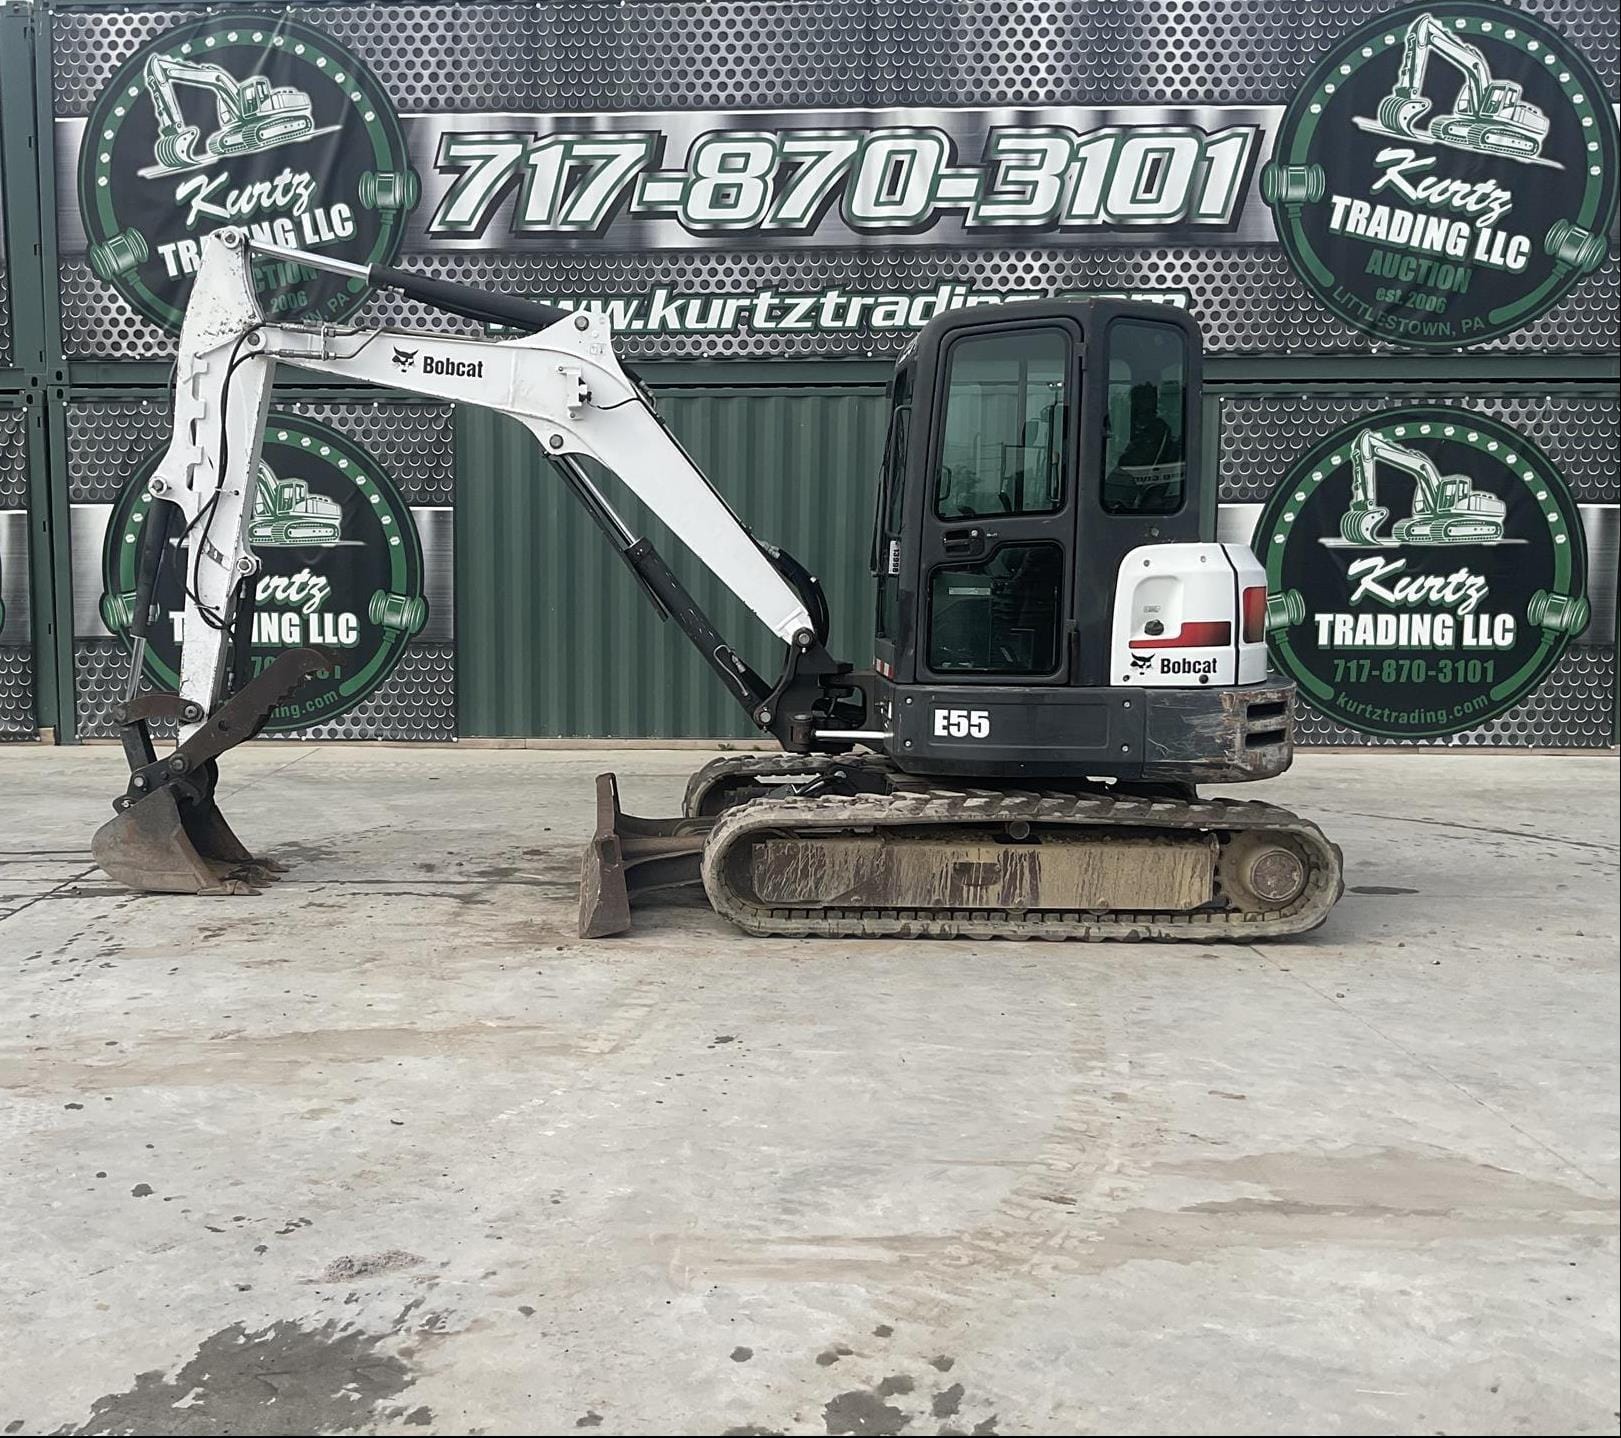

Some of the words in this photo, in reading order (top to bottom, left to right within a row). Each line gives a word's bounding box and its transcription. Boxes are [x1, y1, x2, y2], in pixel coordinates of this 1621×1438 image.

[175, 168, 317, 229] Kurtz
[430, 128, 1262, 235] 717-870-3101
[1370, 147, 1512, 226] Kurtz
[158, 217, 298, 277] TRNG
[302, 204, 355, 245] LLC
[1328, 195, 1471, 258] TRADING
[1474, 226, 1532, 270] LLC
[254, 258, 319, 293] CTION
[1365, 249, 1472, 294] AUCTION
[270, 291, 308, 314] 2006
[328, 291, 350, 312] PA
[1332, 285, 1456, 337] LITTLESTOWN,
[1461, 316, 1485, 333] PA
[1405, 291, 1447, 314] 2006
[423, 356, 483, 378] Bobcat
[1348, 556, 1489, 614] Kurtz
[309, 612, 358, 644] LLC
[1315, 613, 1455, 647] TRADING
[1463, 614, 1516, 647] LLC
[1160, 658, 1217, 674] Bobcat
[1333, 659, 1494, 683] 717-870-3101
[934, 709, 990, 738] E55
[1335, 693, 1488, 725] kurtztrading.com
